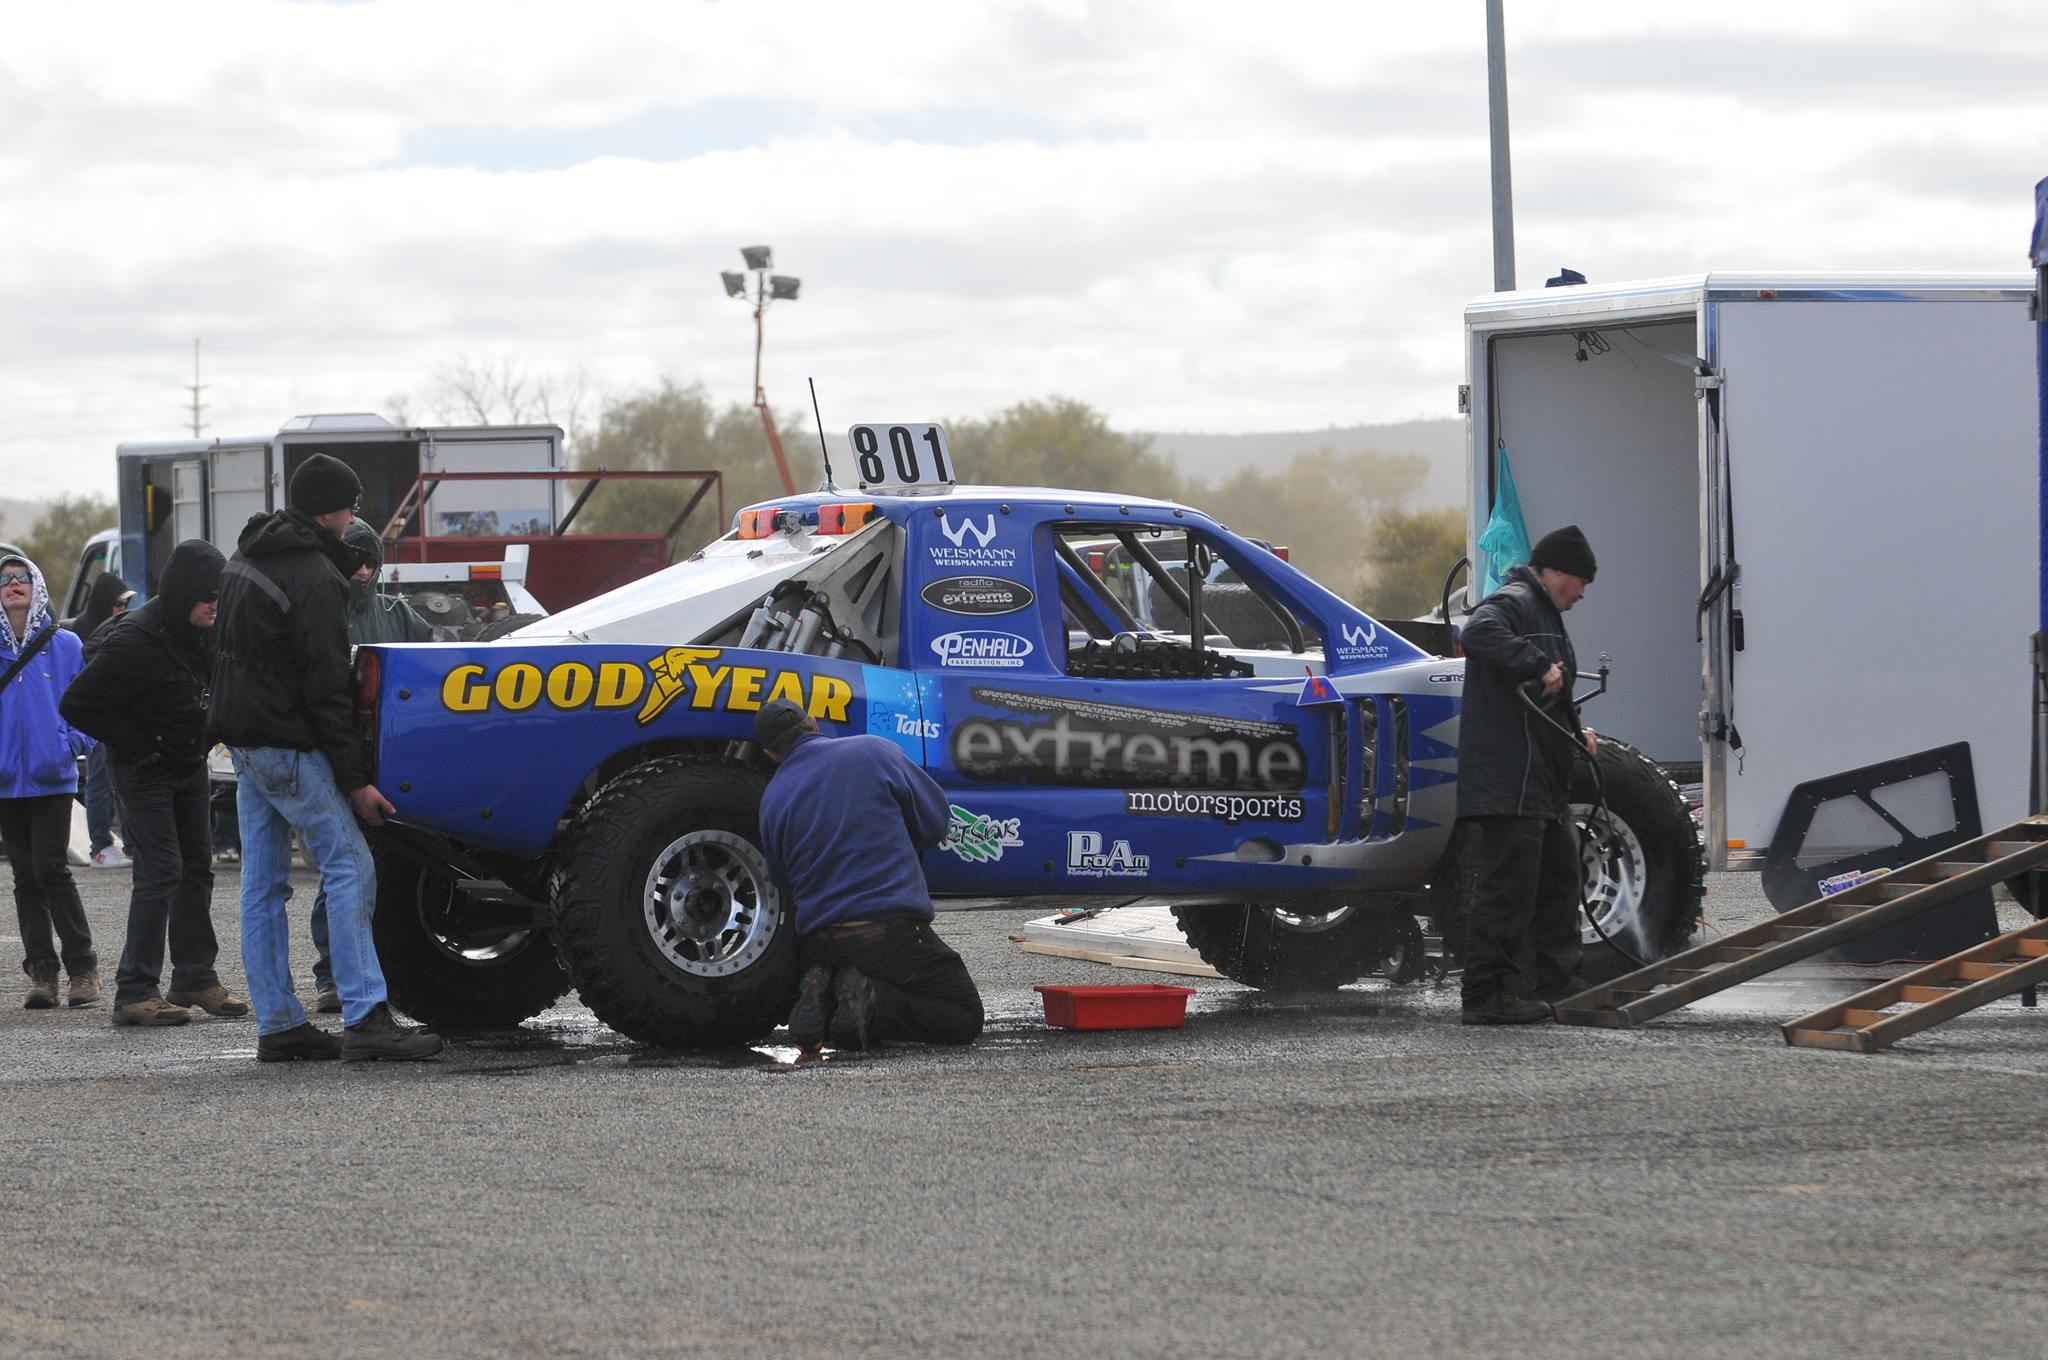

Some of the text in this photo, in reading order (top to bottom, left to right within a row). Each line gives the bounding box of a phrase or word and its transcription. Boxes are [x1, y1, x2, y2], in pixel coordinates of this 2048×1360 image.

[853, 426, 949, 484] 801
[929, 547, 1016, 560] WEISMANN
[934, 558, 1015, 568] WEISMANN.NET
[942, 590, 1014, 606] extreme
[938, 634, 1022, 667] PENHALL
[1336, 645, 1389, 655] WEISMANN
[895, 713, 941, 739] Tatts
[955, 712, 1303, 788] extreme
[1128, 791, 1303, 821] motorsports
